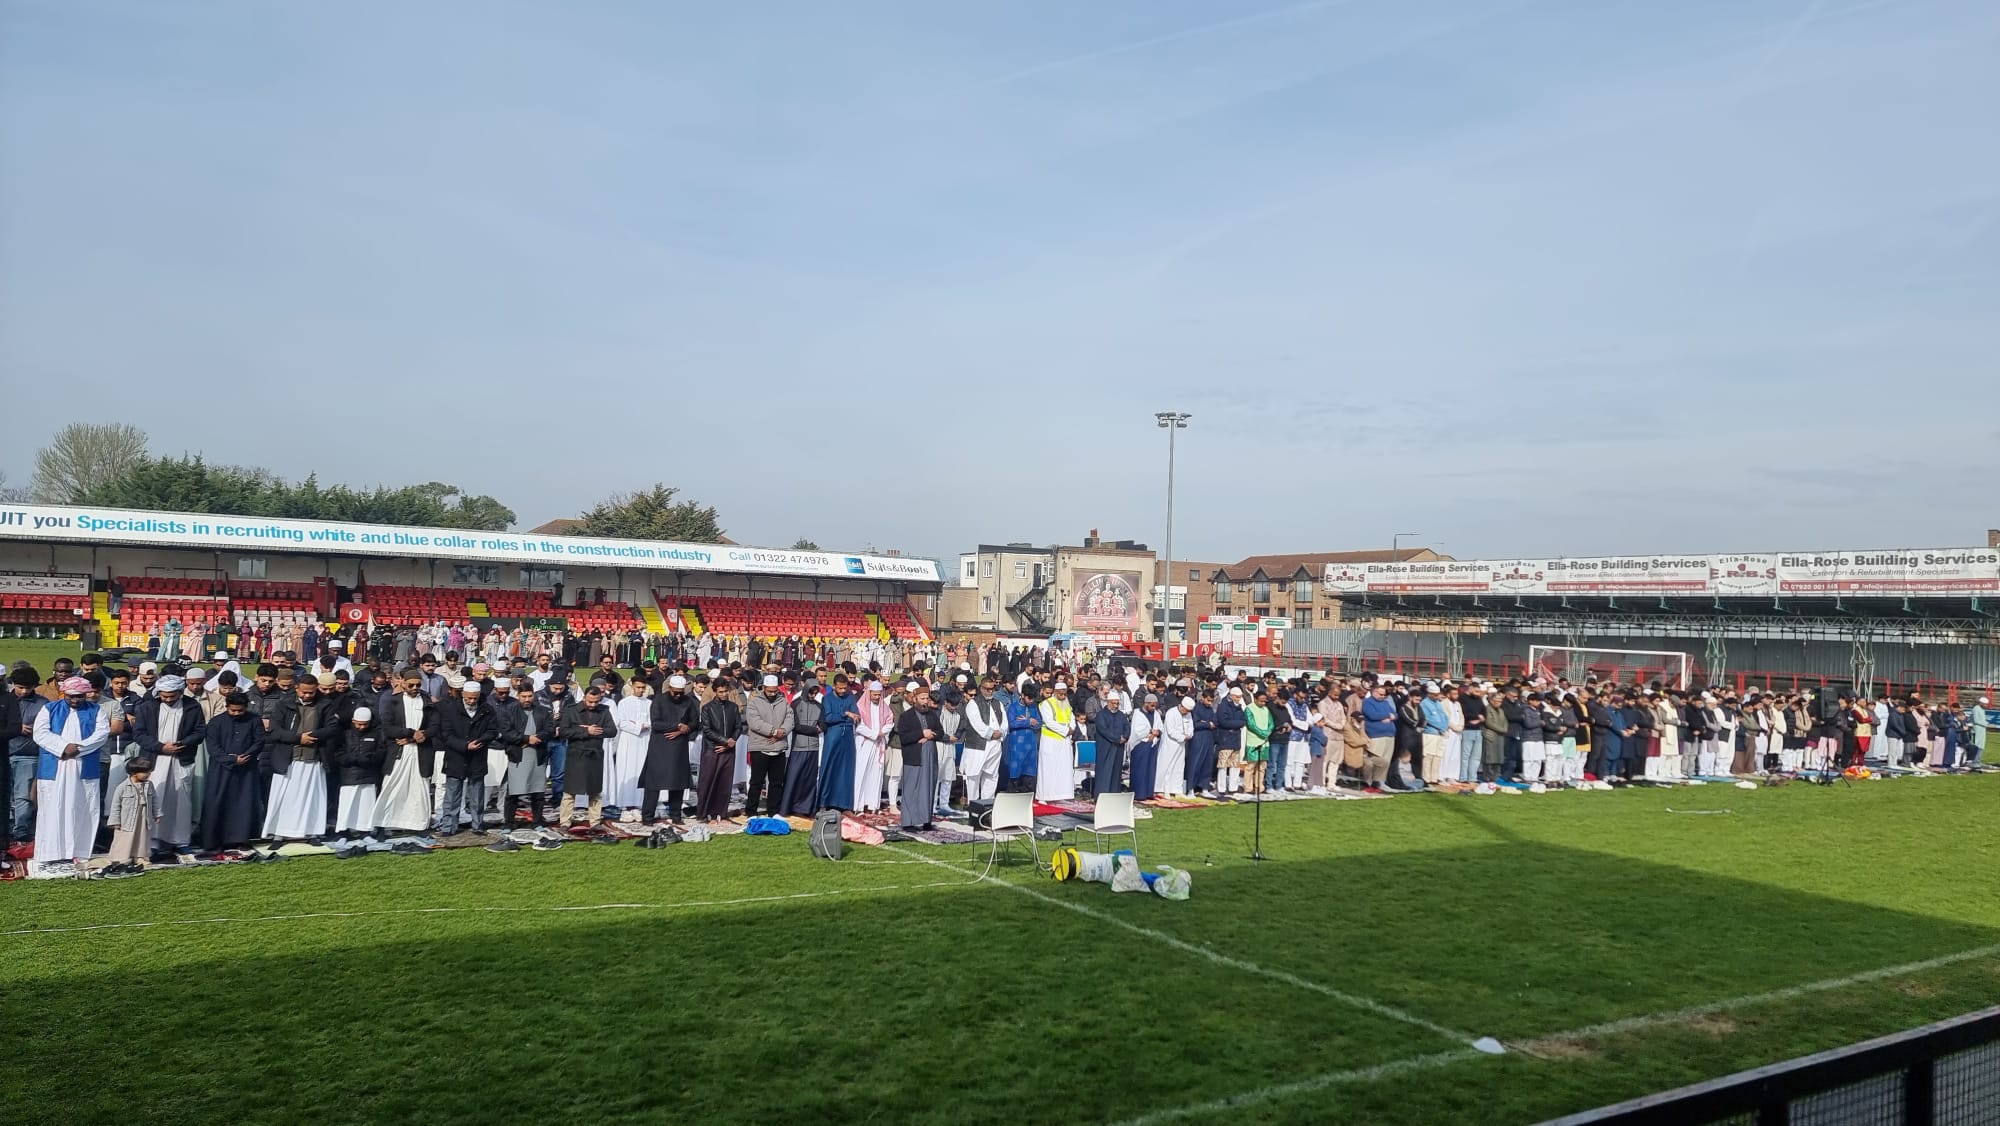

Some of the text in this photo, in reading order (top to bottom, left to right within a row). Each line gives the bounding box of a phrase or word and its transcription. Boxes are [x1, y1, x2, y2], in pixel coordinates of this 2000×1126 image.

[33, 516, 71, 530] you
[77, 515, 711, 564] Specialists in recruiting white and blue collar roles in the construction industry
[729, 551, 829, 566] Call 01322 474976
[1547, 558, 1707, 571] Ella-Rose Building Services
[1781, 553, 1998, 568] Ella-Rose Building Services
[1368, 563, 1490, 574] Ella-Rose Building Services
[122, 635, 144, 643] FIRE
